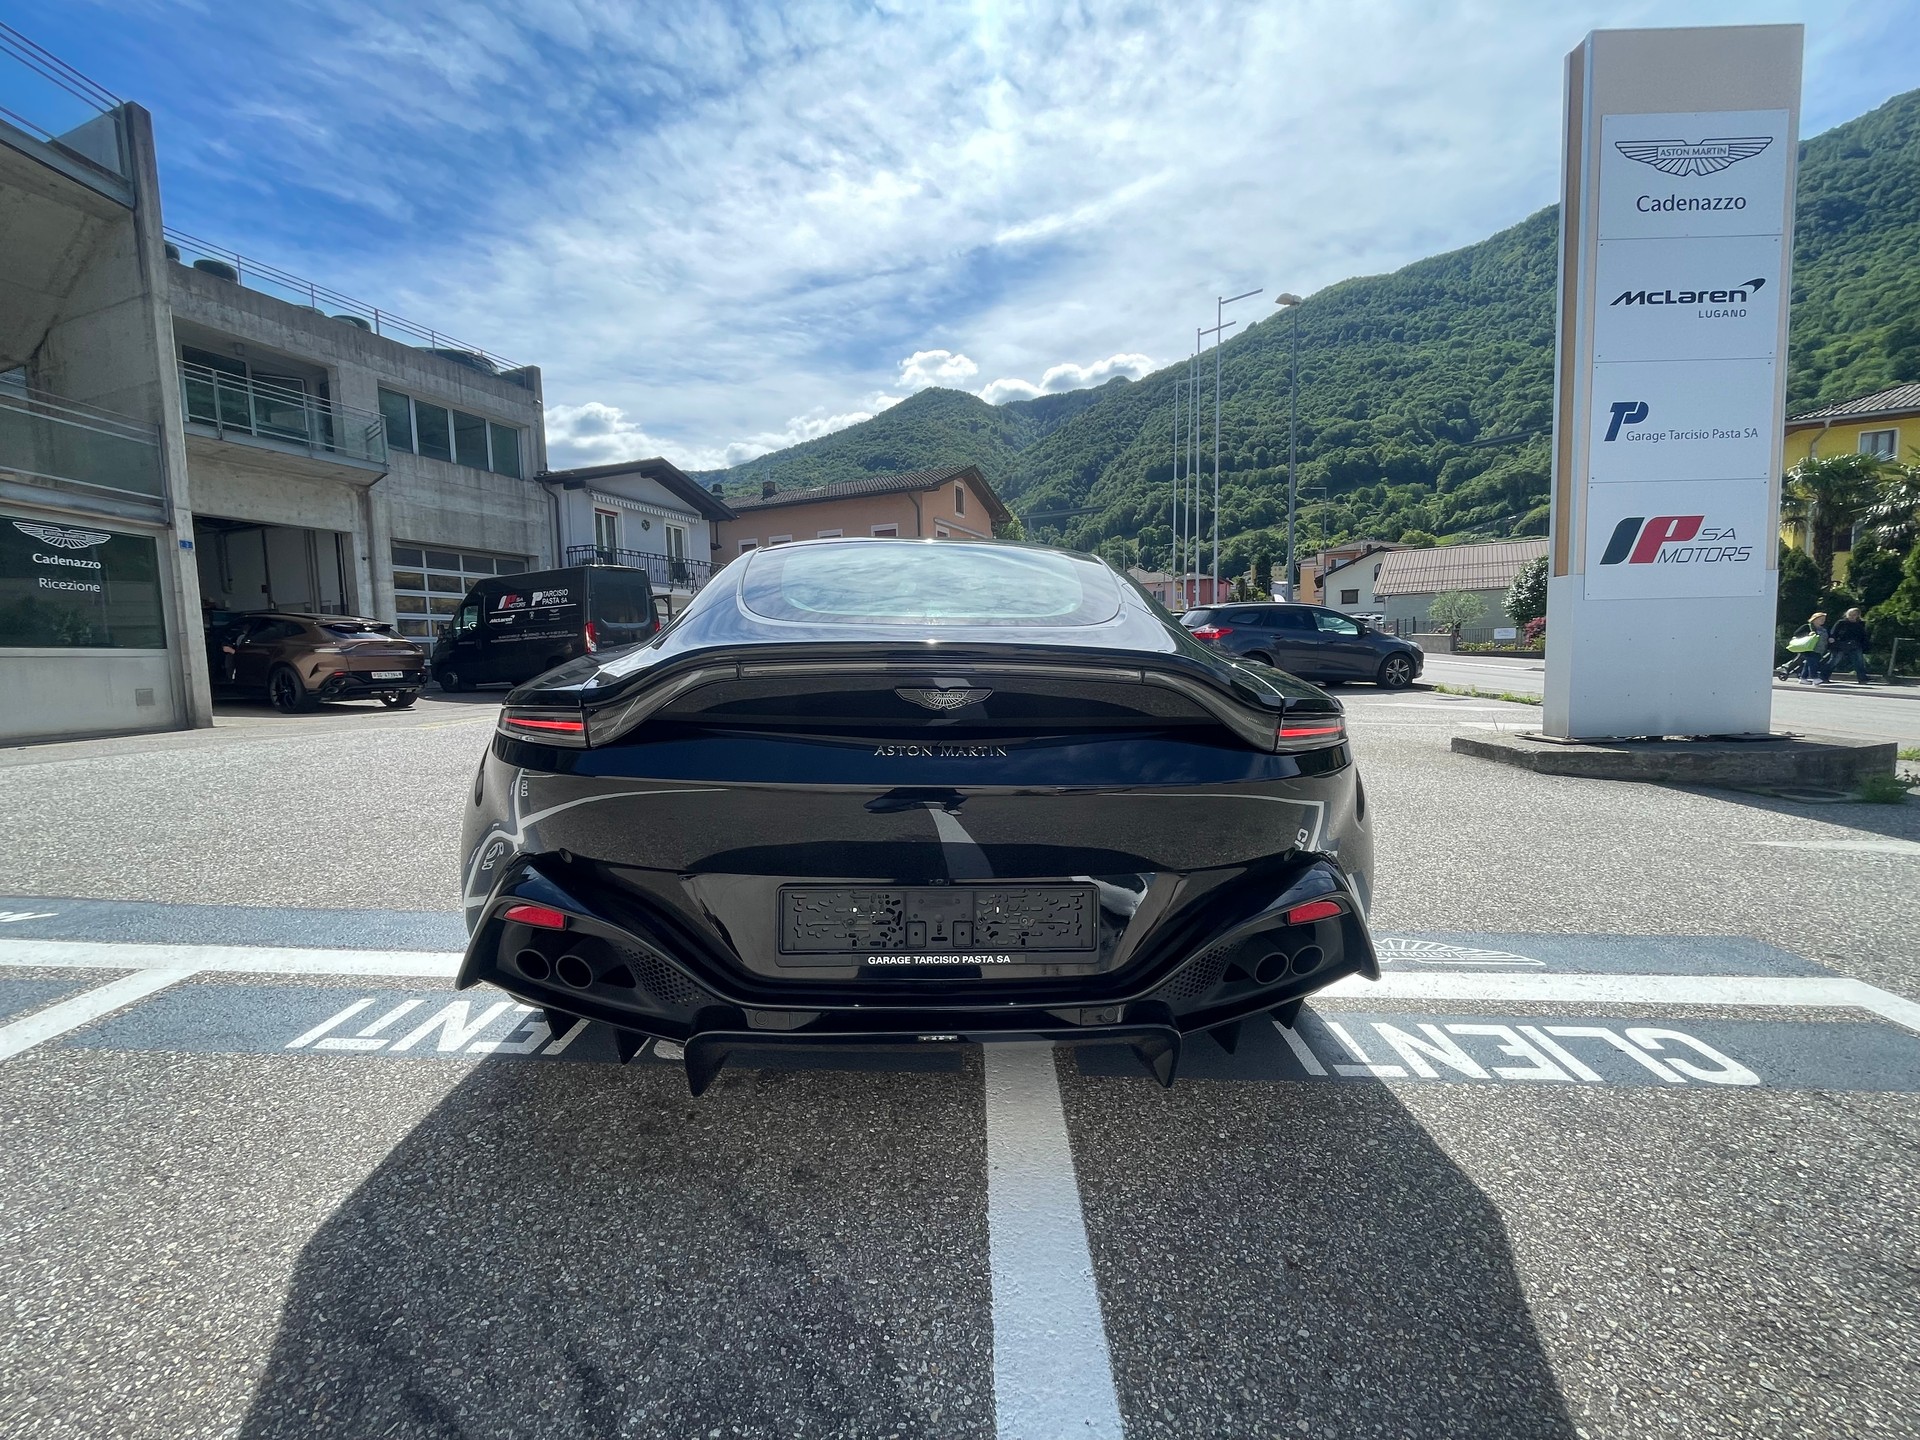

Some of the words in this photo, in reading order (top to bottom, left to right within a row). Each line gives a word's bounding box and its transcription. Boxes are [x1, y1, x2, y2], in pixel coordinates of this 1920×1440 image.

[1659, 148, 1690, 157] ASTON
[1692, 146, 1727, 156] MARTIN
[1636, 193, 1747, 213] Cadenazzo
[1609, 290, 1747, 306] McLaren
[1698, 309, 1747, 318] LUGANO
[1626, 430, 1666, 443] Garage
[1669, 429, 1709, 440] Tarcisio
[1712, 428, 1741, 439] Pasta
[1744, 428, 1759, 438] SA
[1698, 527, 1737, 541] SA
[32, 553, 102, 569] Cadenazzo
[1657, 546, 1753, 564] MOTORS
[38, 577, 101, 593] Ricezione
[543, 588, 569, 598] TARCISIO
[873, 745, 933, 757] ASTON
[940, 745, 1007, 757] MARTIN
[867, 955, 911, 965] GARAGE
[913, 955, 960, 964] TARCISIO
[962, 955, 994, 964] PASTA
[996, 955, 1011, 963] SA
[1272, 1020, 1762, 1086] CLIENTI
